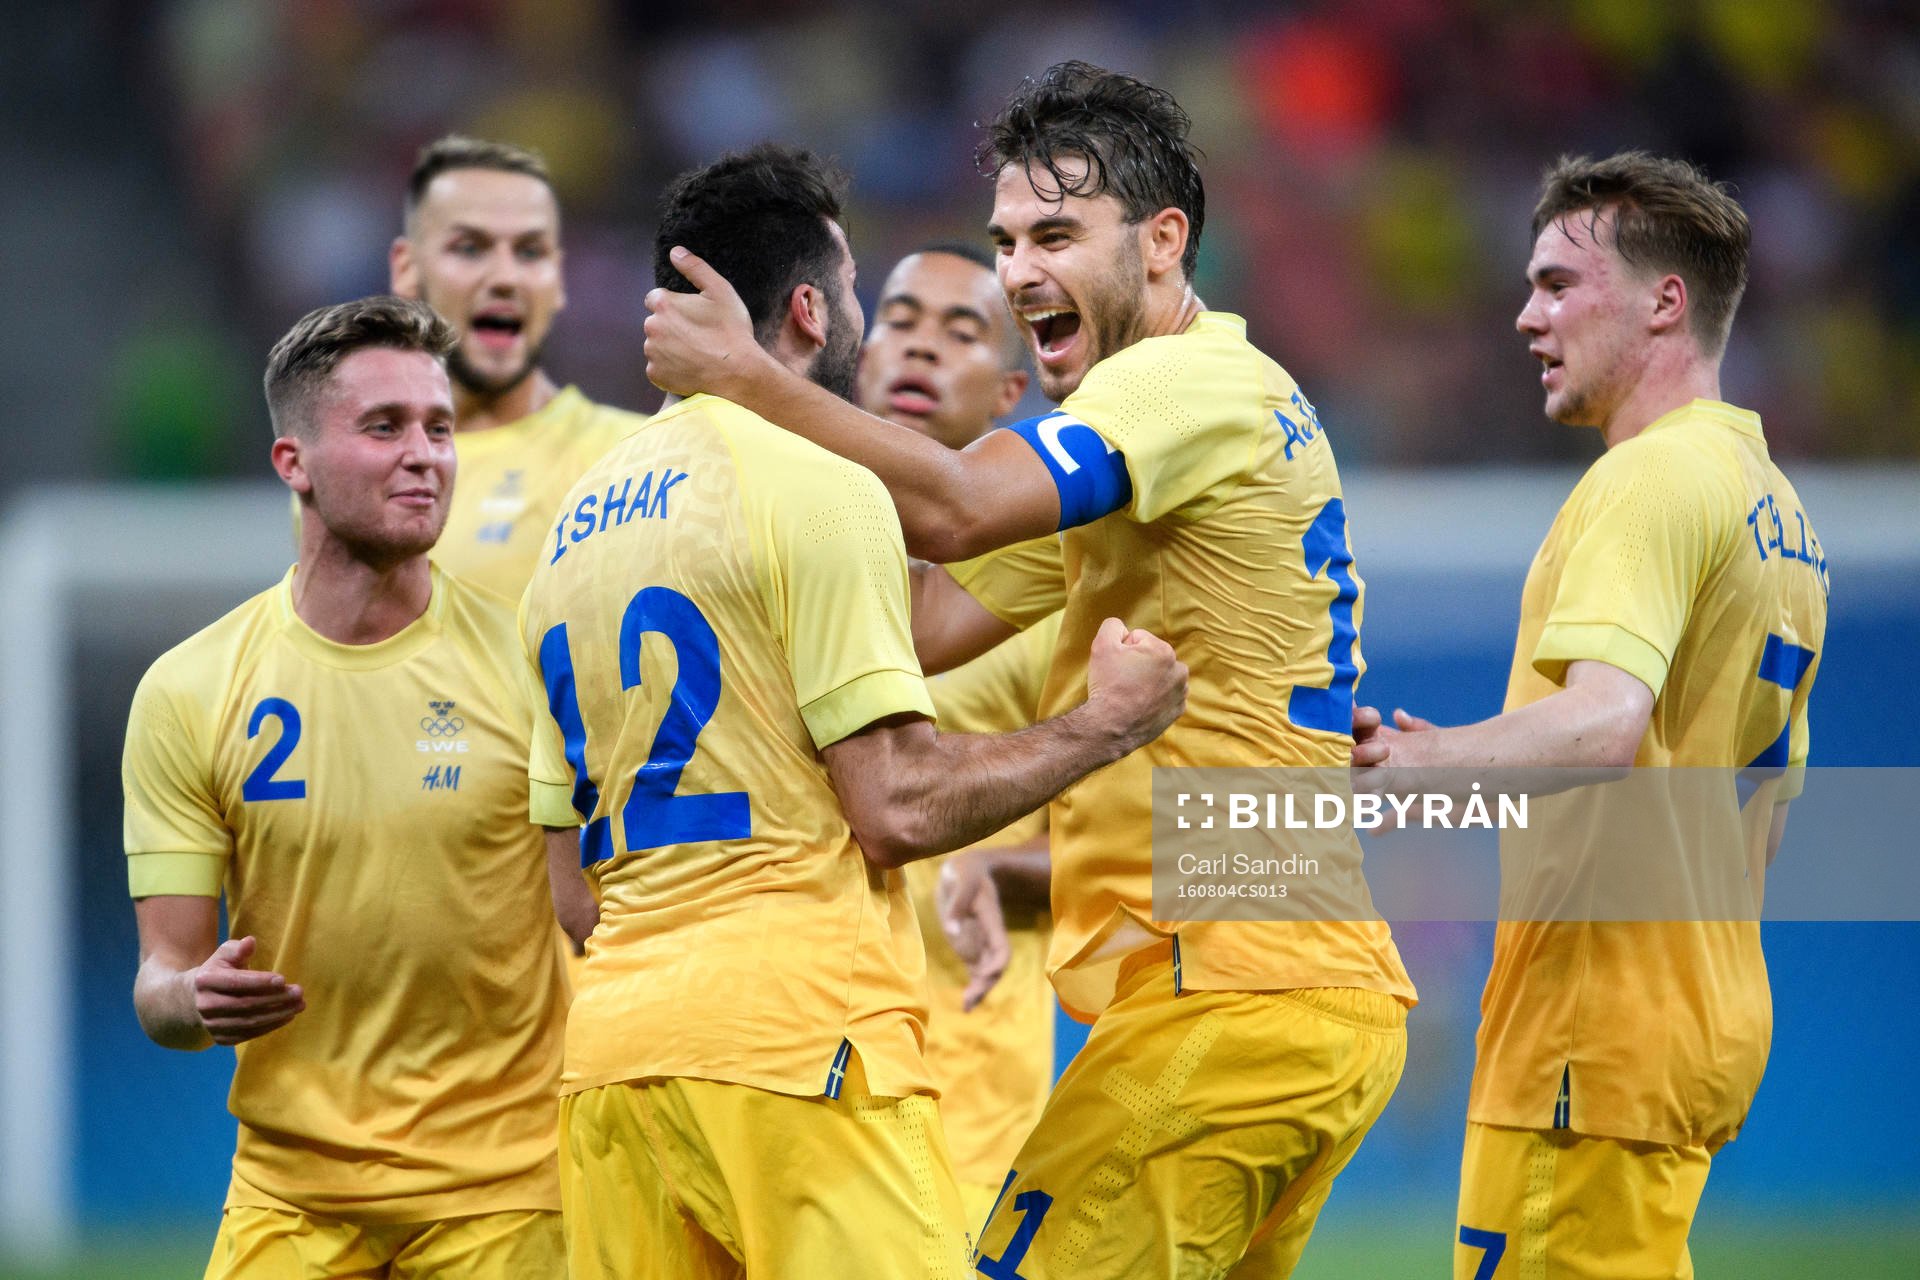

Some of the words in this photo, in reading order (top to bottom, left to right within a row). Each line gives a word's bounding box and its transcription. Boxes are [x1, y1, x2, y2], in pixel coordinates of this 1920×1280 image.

[550, 468, 688, 566] ISHAK
[242, 697, 306, 802] 2
[416, 740, 470, 752] SWE
[539, 586, 752, 869] 12
[422, 765, 461, 791] H&M
[973, 1168, 1054, 1280] 1
[1459, 1224, 1507, 1280] 7
